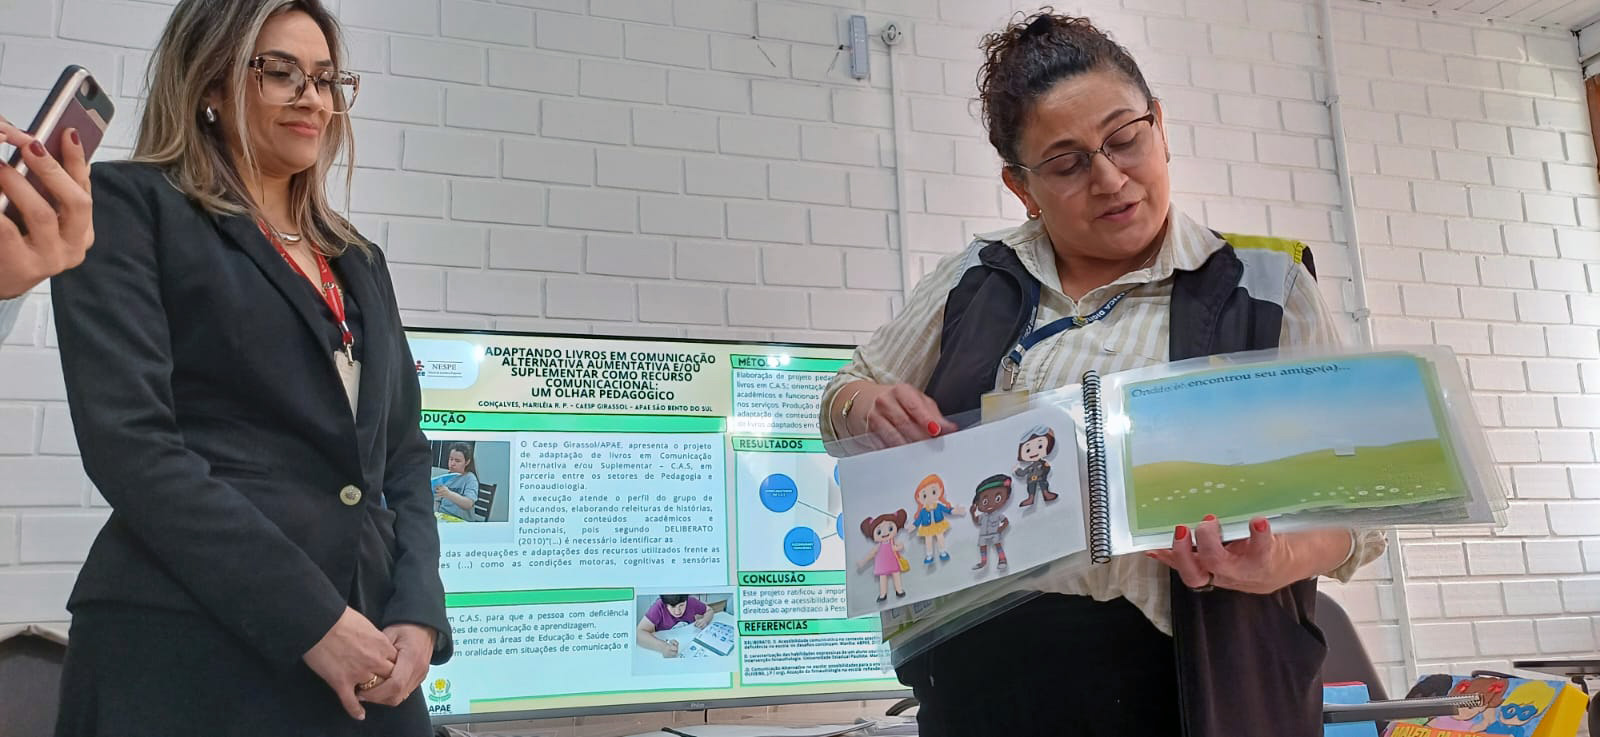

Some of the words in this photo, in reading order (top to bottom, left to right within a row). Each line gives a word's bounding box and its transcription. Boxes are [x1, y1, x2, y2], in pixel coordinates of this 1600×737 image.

[485, 347, 561, 358] ADAPTANDO
[566, 350, 606, 360] LIVROS
[610, 351, 626, 361] EM
[630, 352, 716, 365] COMUNICAÇÃO
[502, 357, 586, 368] ALTERNATIVA
[587, 360, 670, 371] AUMENTATIVA
[673, 362, 700, 372] E/OU
[512, 368, 598, 378] SUPLEMENTAR
[602, 370, 638, 380] COMO
[642, 372, 692, 382] RECURSO
[736, 371, 772, 380] Elaboração
[776, 372, 784, 380] de
[1188, 371, 1251, 388] encontrou
[1254, 370, 1276, 378] seu
[546, 378, 658, 390] COMUNICACIONAL:
[532, 388, 550, 397] UM
[555, 389, 596, 398] OLHAR
[786, 392, 819, 400] funcionais
[478, 400, 521, 408] GONÇALVES,
[782, 402, 814, 411] Produção
[421, 412, 466, 425] DUÇÃO
[736, 411, 772, 419] adaptação
[532, 441, 558, 450] Caesp
[628, 442, 668, 450] apresenta
[684, 442, 712, 452] projeto
[740, 440, 803, 449] RESULTADOS
[540, 452, 583, 460] adaptação
[660, 452, 712, 461] Comunicação
[600, 462, 652, 471] Suplementar
[520, 472, 555, 480] parceria
[644, 472, 654, 480] de
[661, 472, 702, 481] Pedagogia
[520, 482, 588, 491] Fonoaudiologia.
[532, 495, 572, 503] execução
[580, 494, 608, 502] atende
[628, 494, 649, 503] perfil
[656, 494, 666, 502] do
[673, 495, 696, 504] grupo
[704, 494, 712, 502] de
[519, 506, 568, 514] educandos,
[571, 505, 618, 513] elaborando
[676, 504, 713, 513] histórias,
[518, 516, 565, 525] adaptando
[518, 527, 566, 536] funcionais,
[582, 527, 600, 536] pois
[614, 526, 650, 535] segundo
[572, 536, 618, 544] necessário
[620, 536, 662, 544] identificar
[446, 550, 462, 558] das
[465, 548, 518, 559] adequações
[530, 548, 580, 557] adaptações
[584, 547, 599, 555] dos
[642, 546, 680, 554] utilizados
[528, 559, 572, 568] condições
[580, 558, 617, 566] motoras,
[624, 558, 664, 567] cognitivas
[682, 556, 720, 564] sensórias
[742, 572, 806, 584] CONCLUSÃO
[760, 590, 785, 598] projeto
[787, 588, 816, 596] ratificou
[742, 598, 782, 607] pedagógica
[459, 614, 482, 623] C.A.S.
[486, 614, 504, 624] para
[508, 614, 524, 623] que
[538, 612, 564, 621] pessoa
[589, 609, 628, 618] deficiência
[468, 626, 478, 634] de
[480, 624, 532, 634] comunicação
[540, 621, 596, 632] aprendizagem.
[744, 620, 808, 632] REFERENCIAS
[500, 636, 522, 644] áreas
[525, 634, 535, 642] de
[538, 633, 575, 643] Educação
[586, 632, 610, 640] Saúde
[612, 631, 628, 639] com
[465, 648, 502, 656] oralidade
[521, 645, 557, 656] situações
[560, 644, 570, 652] de
[572, 642, 622, 652] comunicação
[429, 704, 451, 712] APAE
